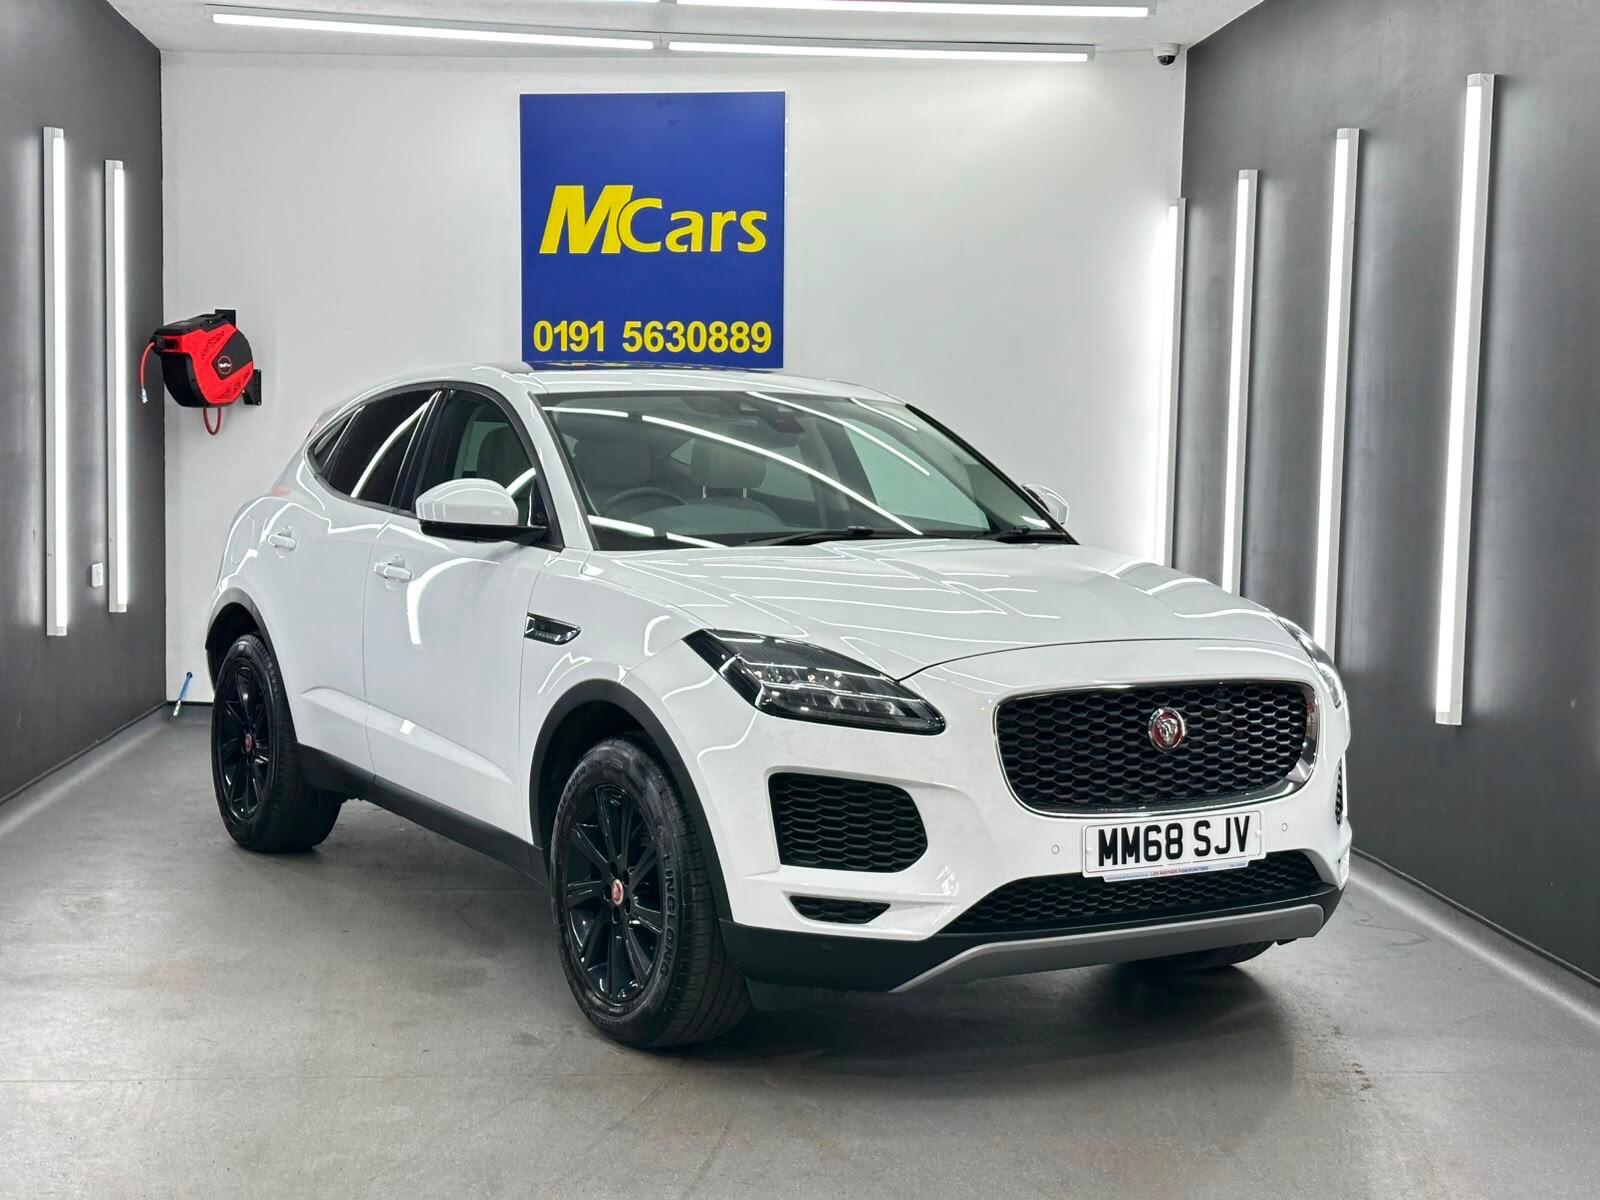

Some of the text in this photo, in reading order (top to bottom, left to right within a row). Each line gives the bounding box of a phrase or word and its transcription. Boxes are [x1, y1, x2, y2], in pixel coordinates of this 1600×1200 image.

[533, 320, 772, 354] 0191 5630889
[1098, 815, 1250, 867] MM68 SJV
